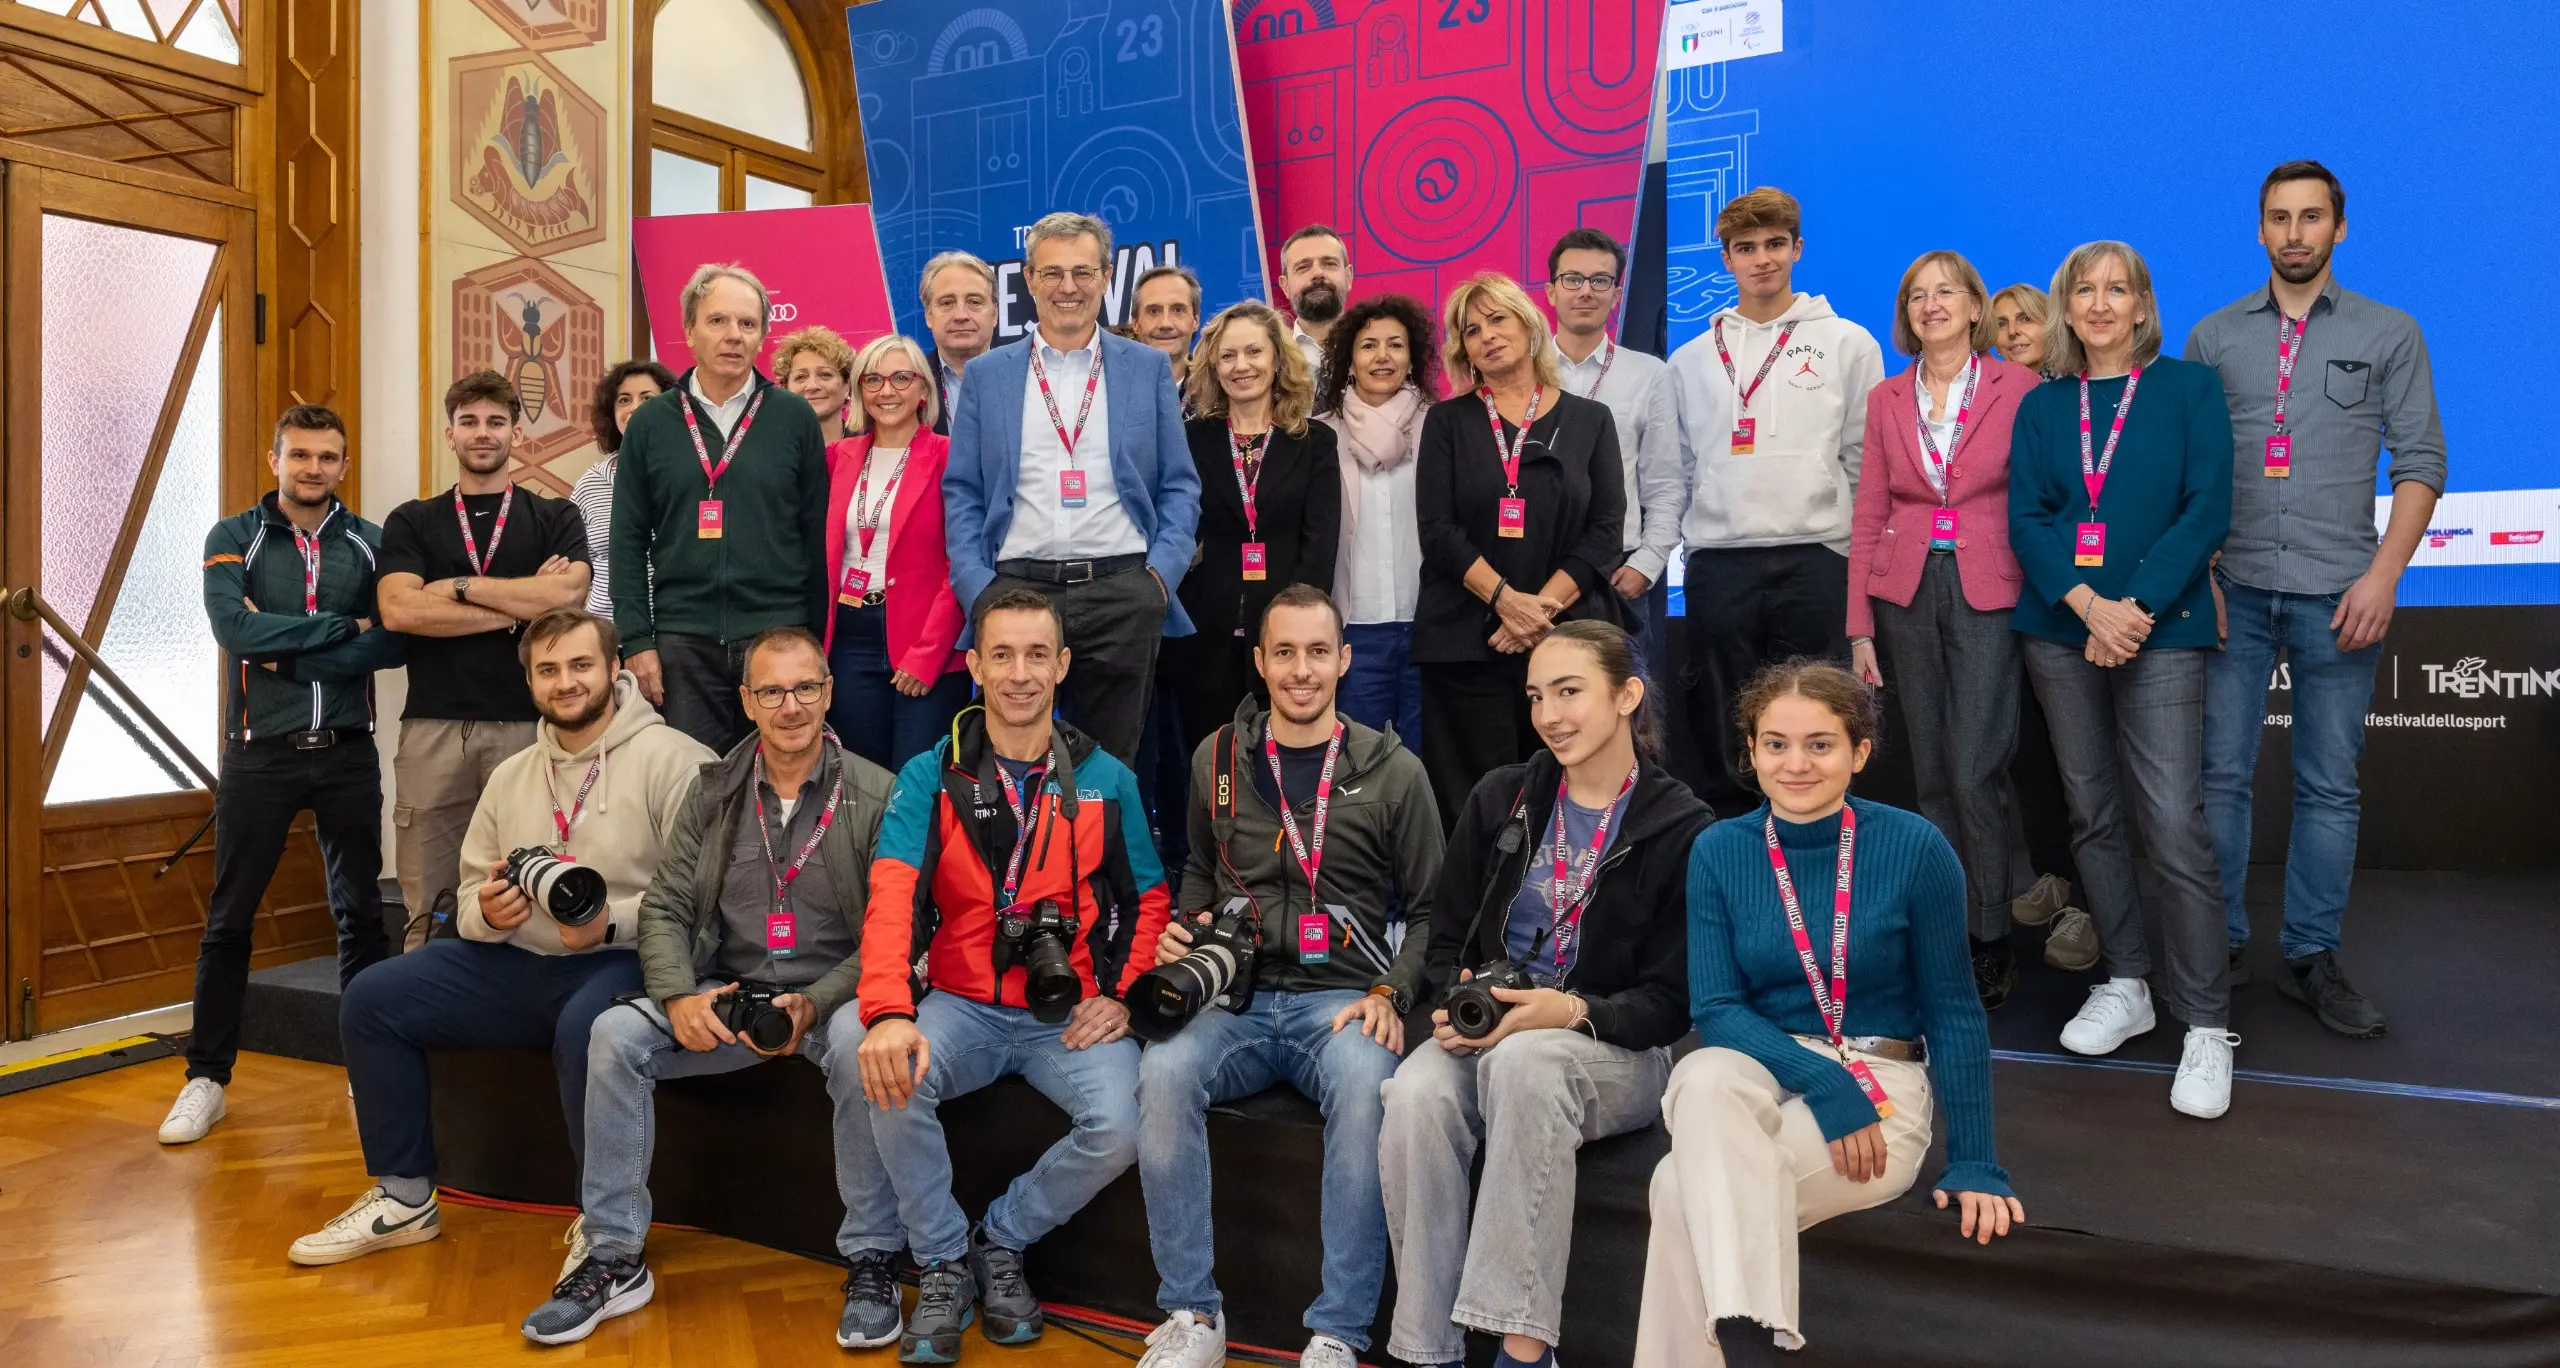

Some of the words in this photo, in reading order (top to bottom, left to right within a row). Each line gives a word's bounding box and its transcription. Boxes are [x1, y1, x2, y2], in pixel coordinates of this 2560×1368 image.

[1116, 14, 1164, 63] 23
[1701, 28, 1723, 38] CONI
[1786, 345, 1825, 359] PARIS
[2425, 528, 2473, 536] SELUNGA
[2364, 713, 2506, 731] lfestivaldellosport
[1219, 774, 1230, 806] EOS
[1215, 928, 1232, 938] Canon
[1475, 971, 1492, 980] Canon
